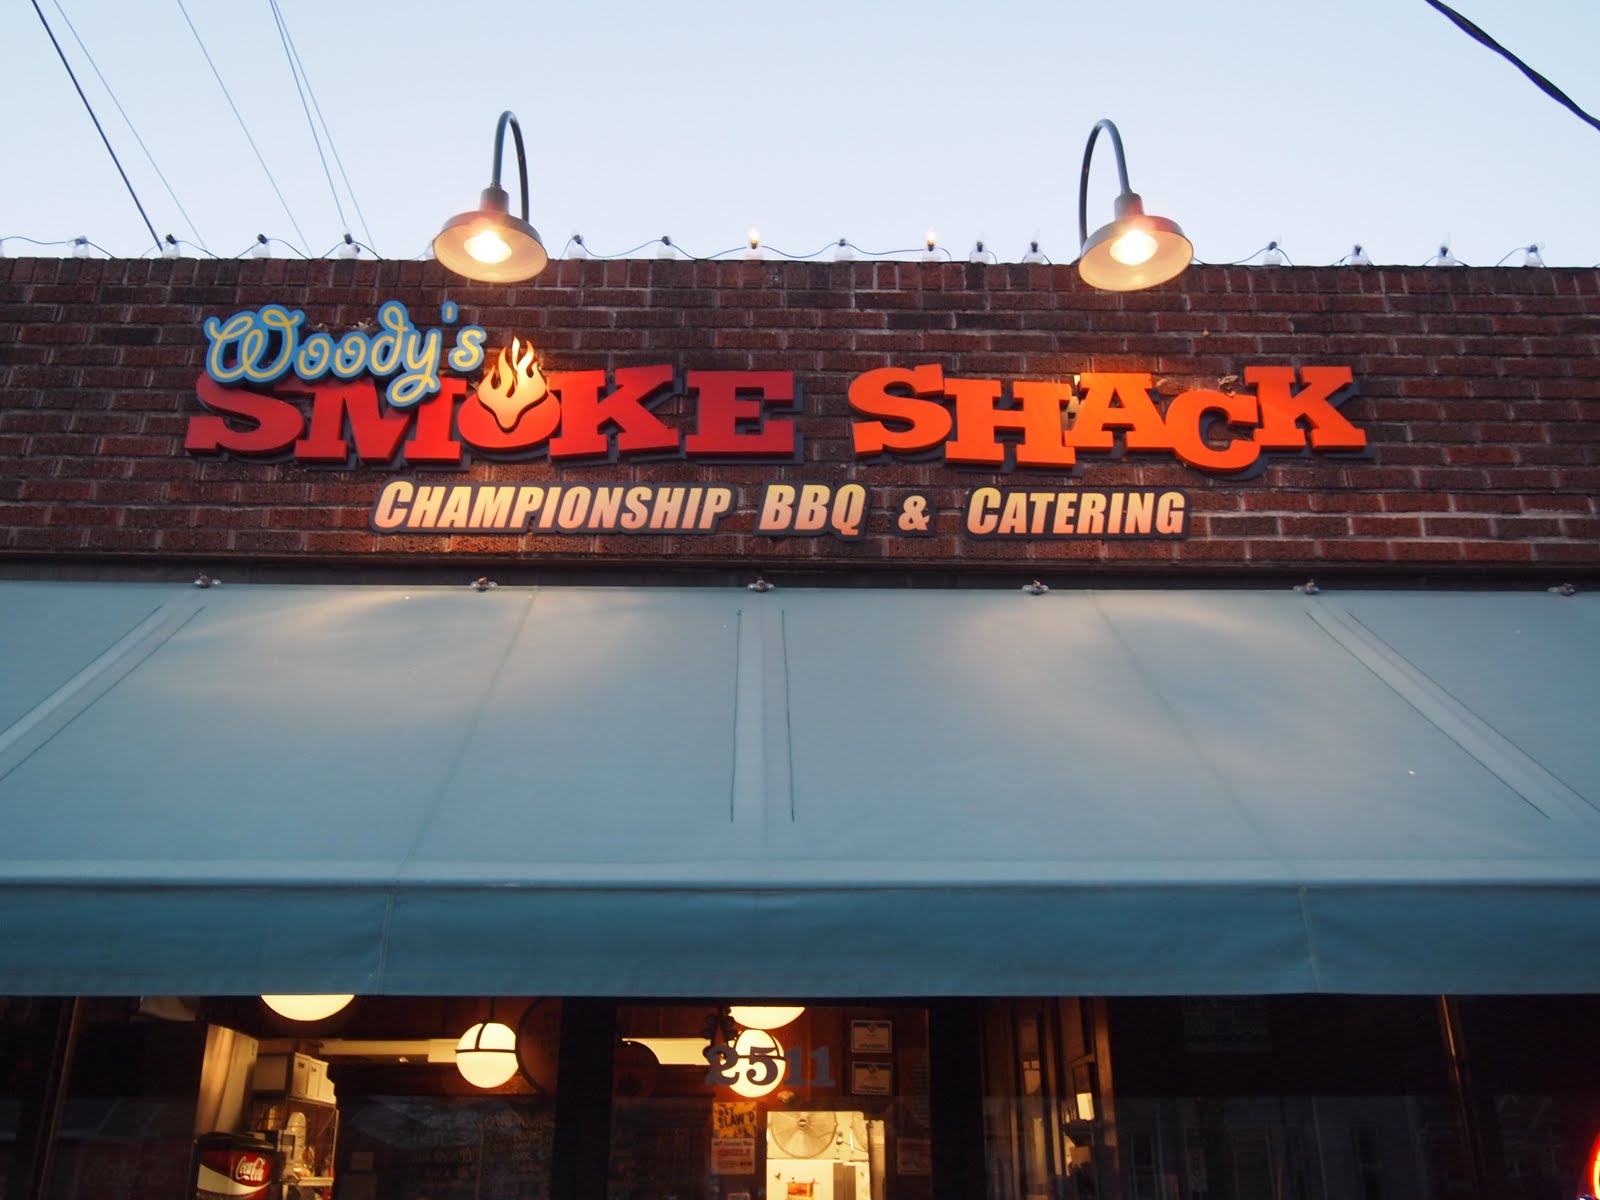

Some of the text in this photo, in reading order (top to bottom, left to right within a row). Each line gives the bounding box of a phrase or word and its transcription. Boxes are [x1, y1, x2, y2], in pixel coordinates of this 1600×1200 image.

[204, 301, 486, 407] Woody's
[185, 363, 1367, 472] SMOKE SHACK
[374, 481, 1185, 536] CHAMPIONSHIP BBQ & CATERING
[703, 1044, 837, 1087] 2511
